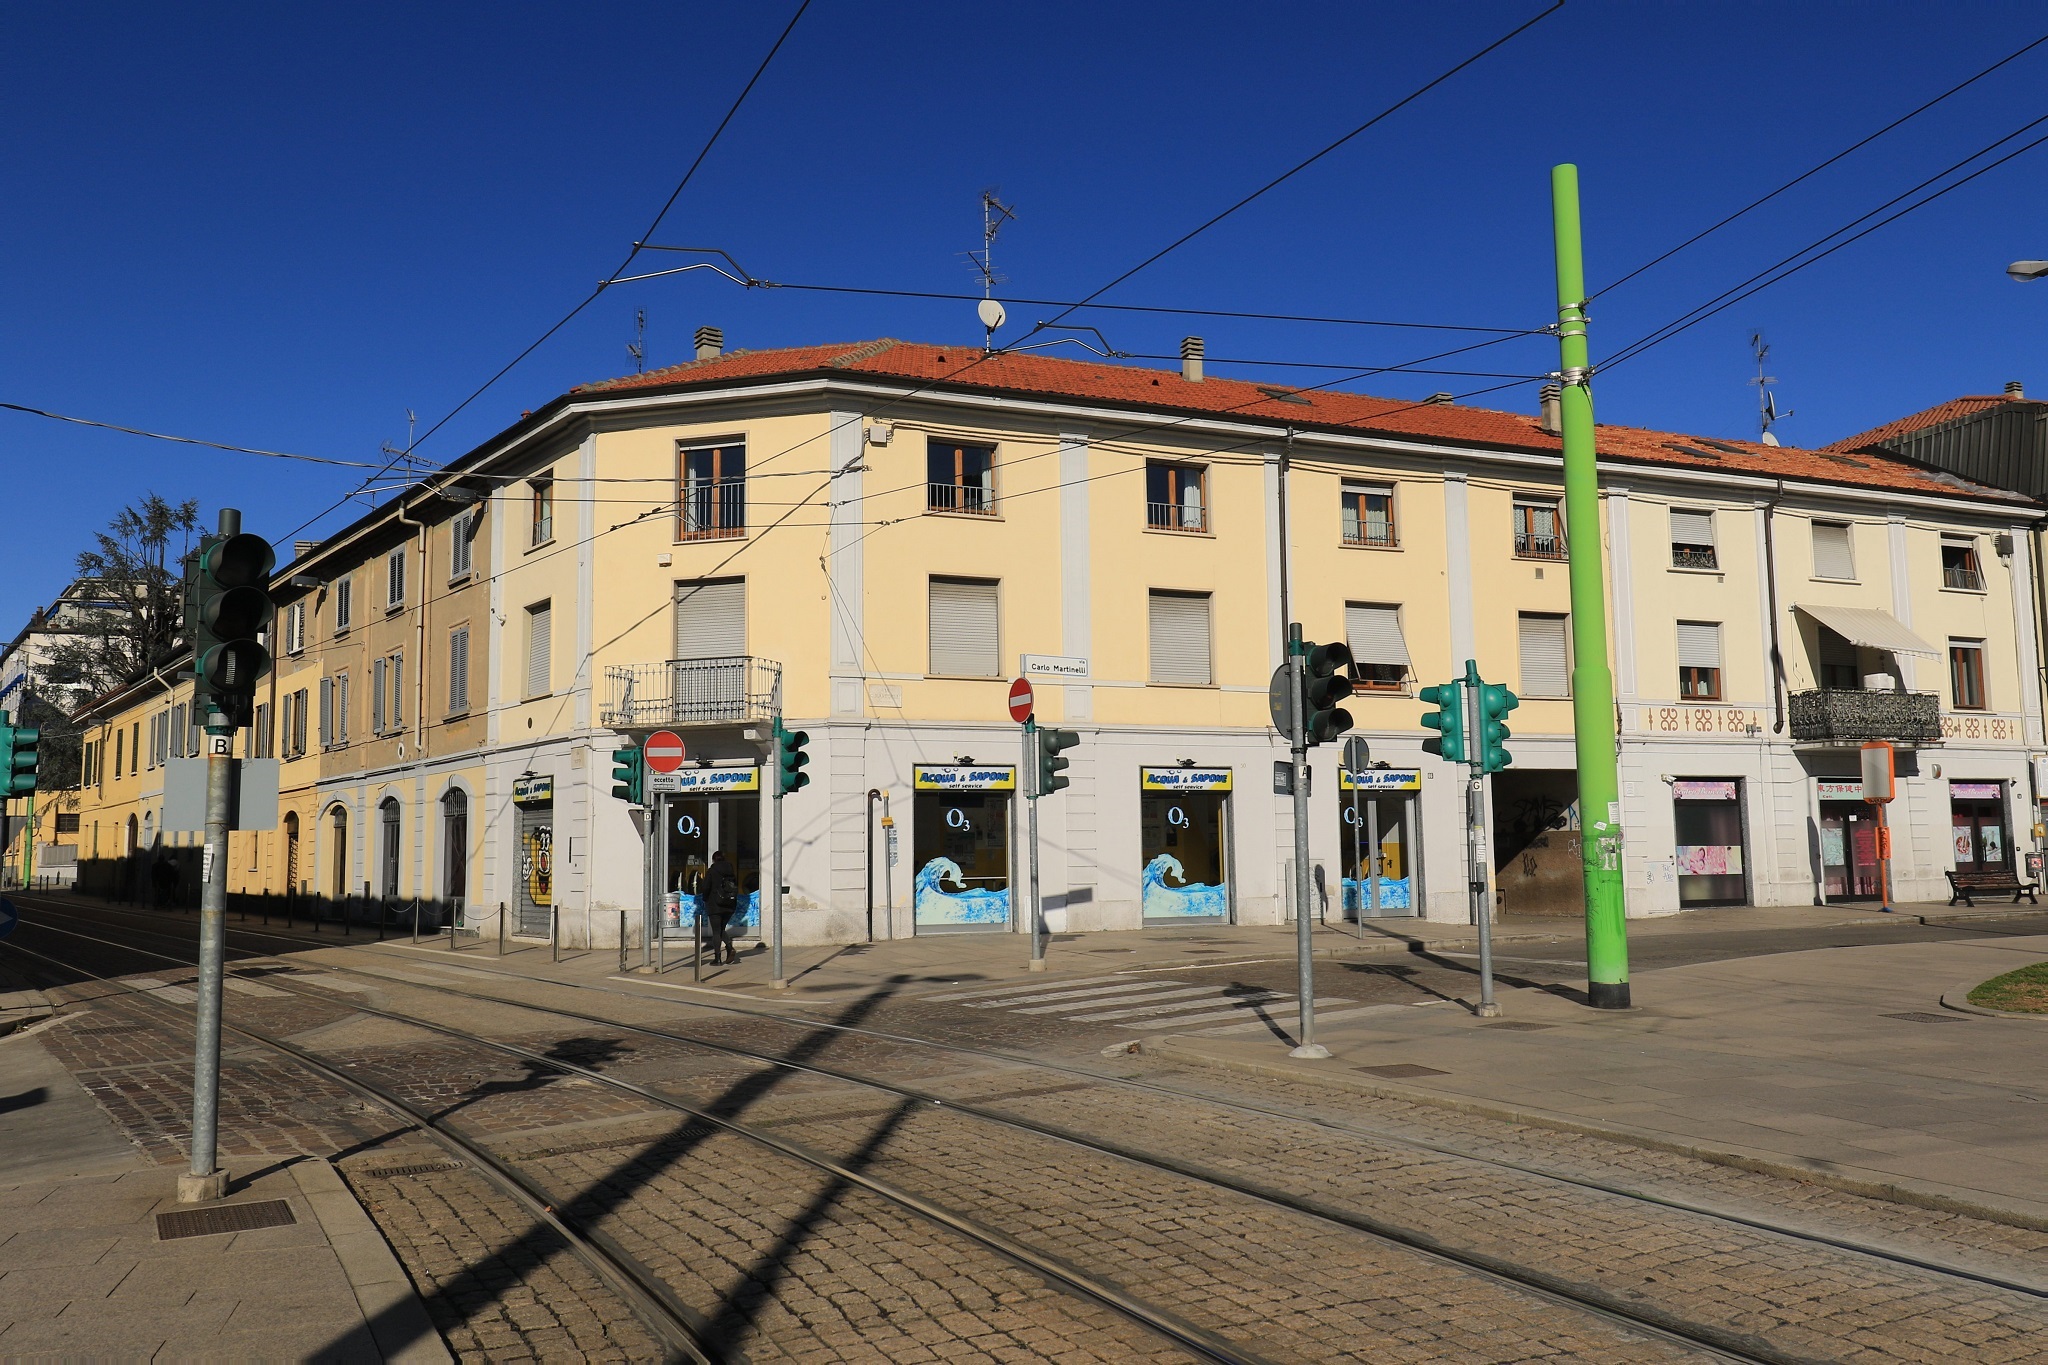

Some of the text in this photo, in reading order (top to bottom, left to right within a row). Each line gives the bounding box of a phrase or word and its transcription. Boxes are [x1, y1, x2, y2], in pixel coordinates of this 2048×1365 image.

[1031, 663, 1086, 674] Carlo Martinelli
[215, 738, 227, 754] B
[709, 773, 752, 784] SAPONE
[919, 771, 1010, 783] ACQUA & SAPONE
[1146, 773, 1180, 784] ACQUA
[1190, 773, 1228, 784] SAPONE
[1383, 774, 1416, 783] SAPONE
[1473, 781, 1480, 790] G
